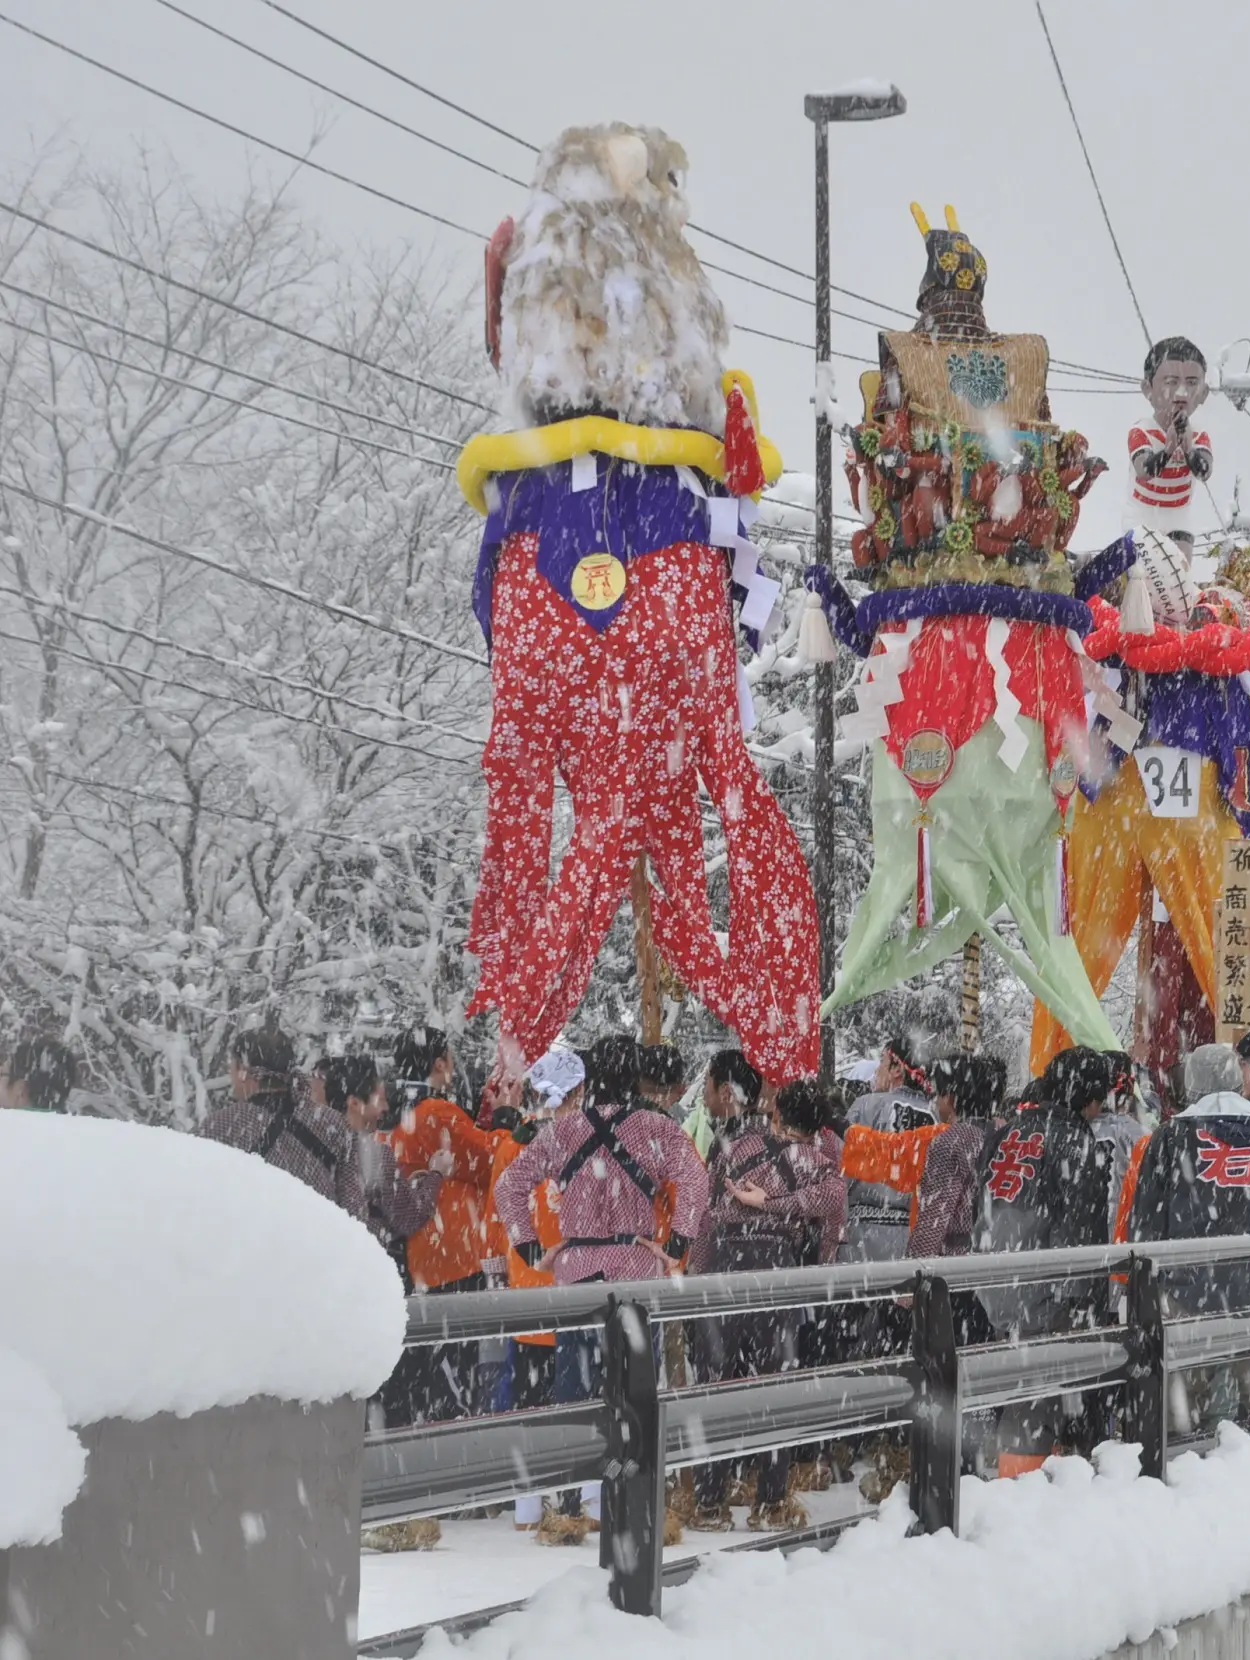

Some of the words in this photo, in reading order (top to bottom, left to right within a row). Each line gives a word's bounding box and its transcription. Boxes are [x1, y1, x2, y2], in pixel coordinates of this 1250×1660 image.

[1144, 757, 1193, 807] 34
[1221, 884, 1249, 1025] 商売繁盛
